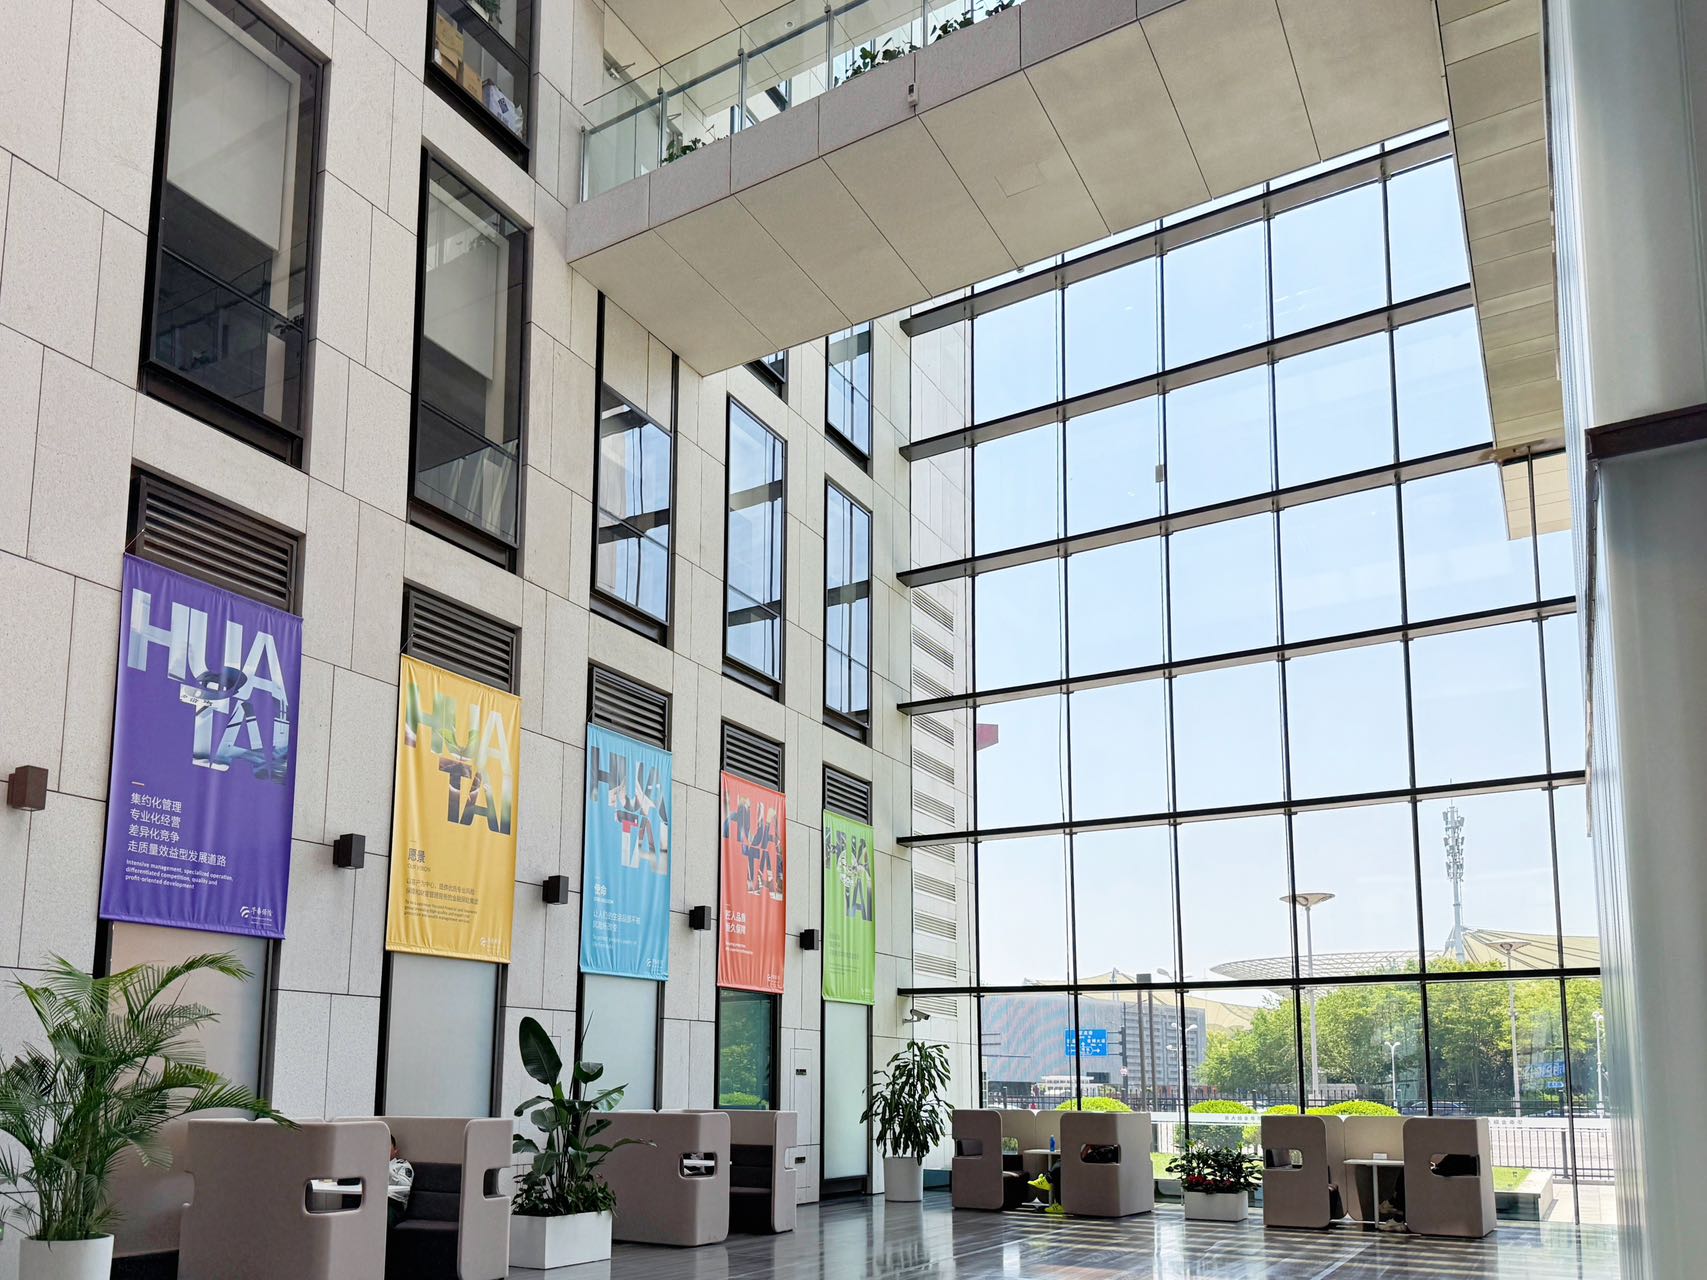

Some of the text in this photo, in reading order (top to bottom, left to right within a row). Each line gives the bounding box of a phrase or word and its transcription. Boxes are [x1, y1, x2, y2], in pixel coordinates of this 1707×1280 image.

[127, 588, 288, 705] HUA
[404, 682, 512, 775] HUA
[438, 757, 512, 836] TAI
[590, 746, 668, 824] HUA
[130, 792, 182, 813] 集约化管理
[130, 808, 181, 829] 专业化经营
[723, 793, 780, 853] HUA
[128, 824, 180, 843] 差异化竞争
[615, 809, 668, 876] TAI
[126, 859, 150, 868] Intensive
[151, 862, 183, 873] management,
[127, 840, 227, 867] 走质量效益型发展道路
[125, 875, 195, 889] profit-oriented development
[126, 867, 160, 877] differentiated
